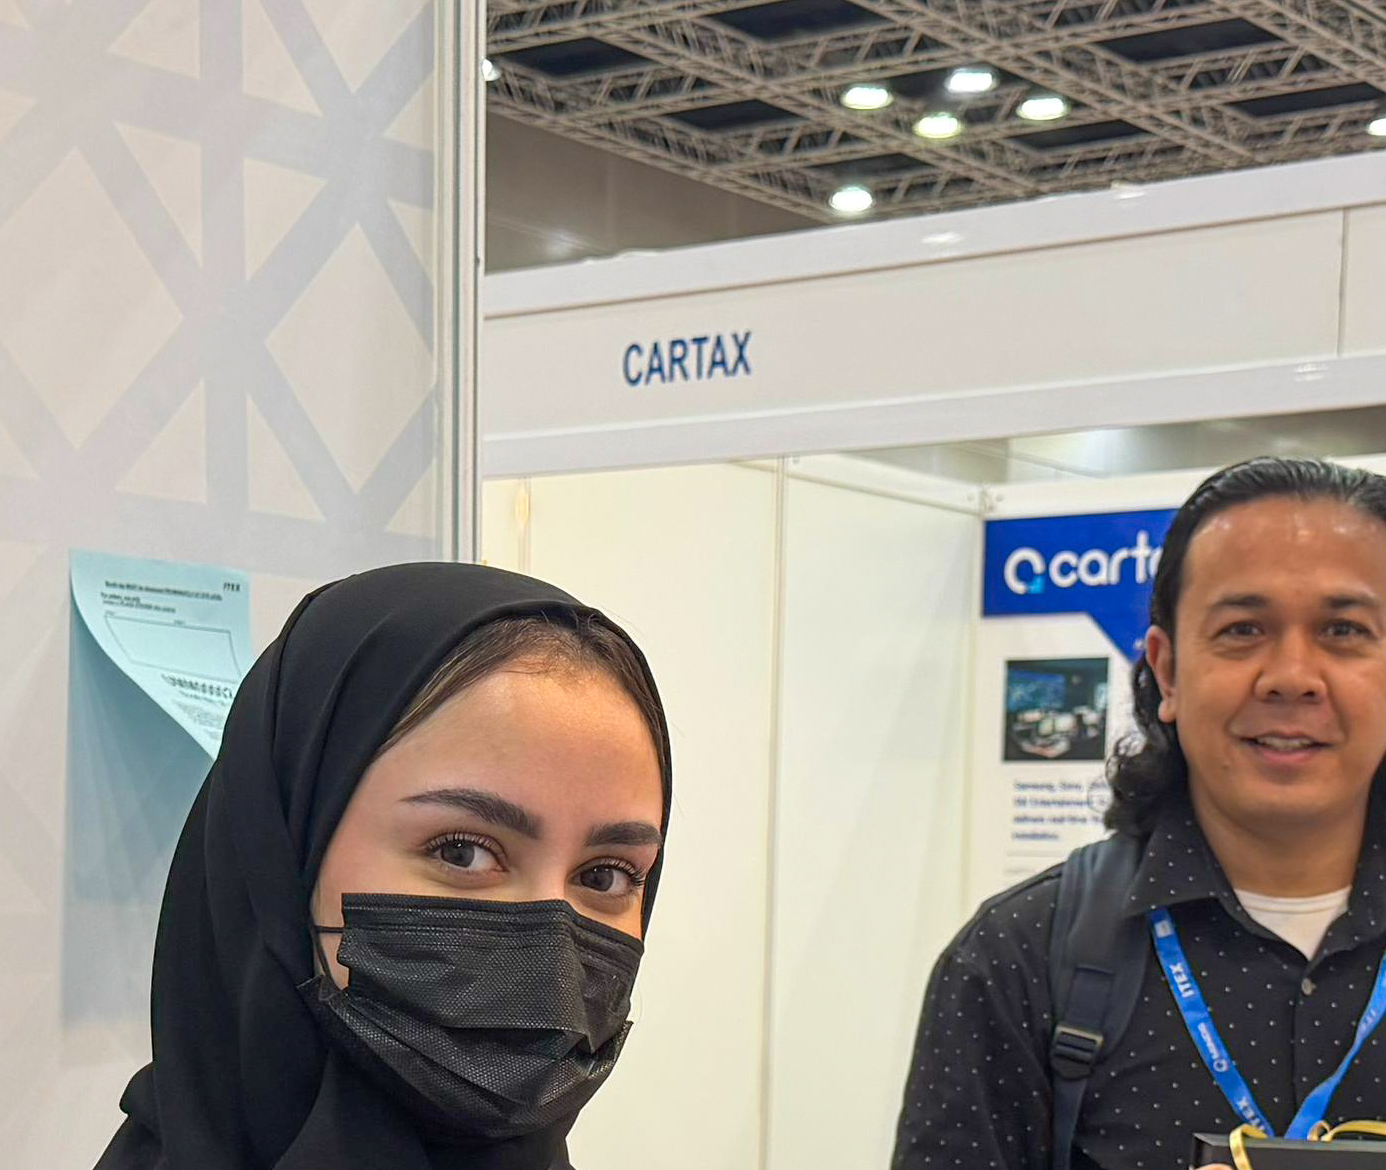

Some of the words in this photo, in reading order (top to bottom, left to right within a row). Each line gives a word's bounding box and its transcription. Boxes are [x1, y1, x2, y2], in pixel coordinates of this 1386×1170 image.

[623, 331, 751, 387] CARTAX
[1049, 530, 1163, 588] cart
[1169, 964, 1195, 998] ITEX
